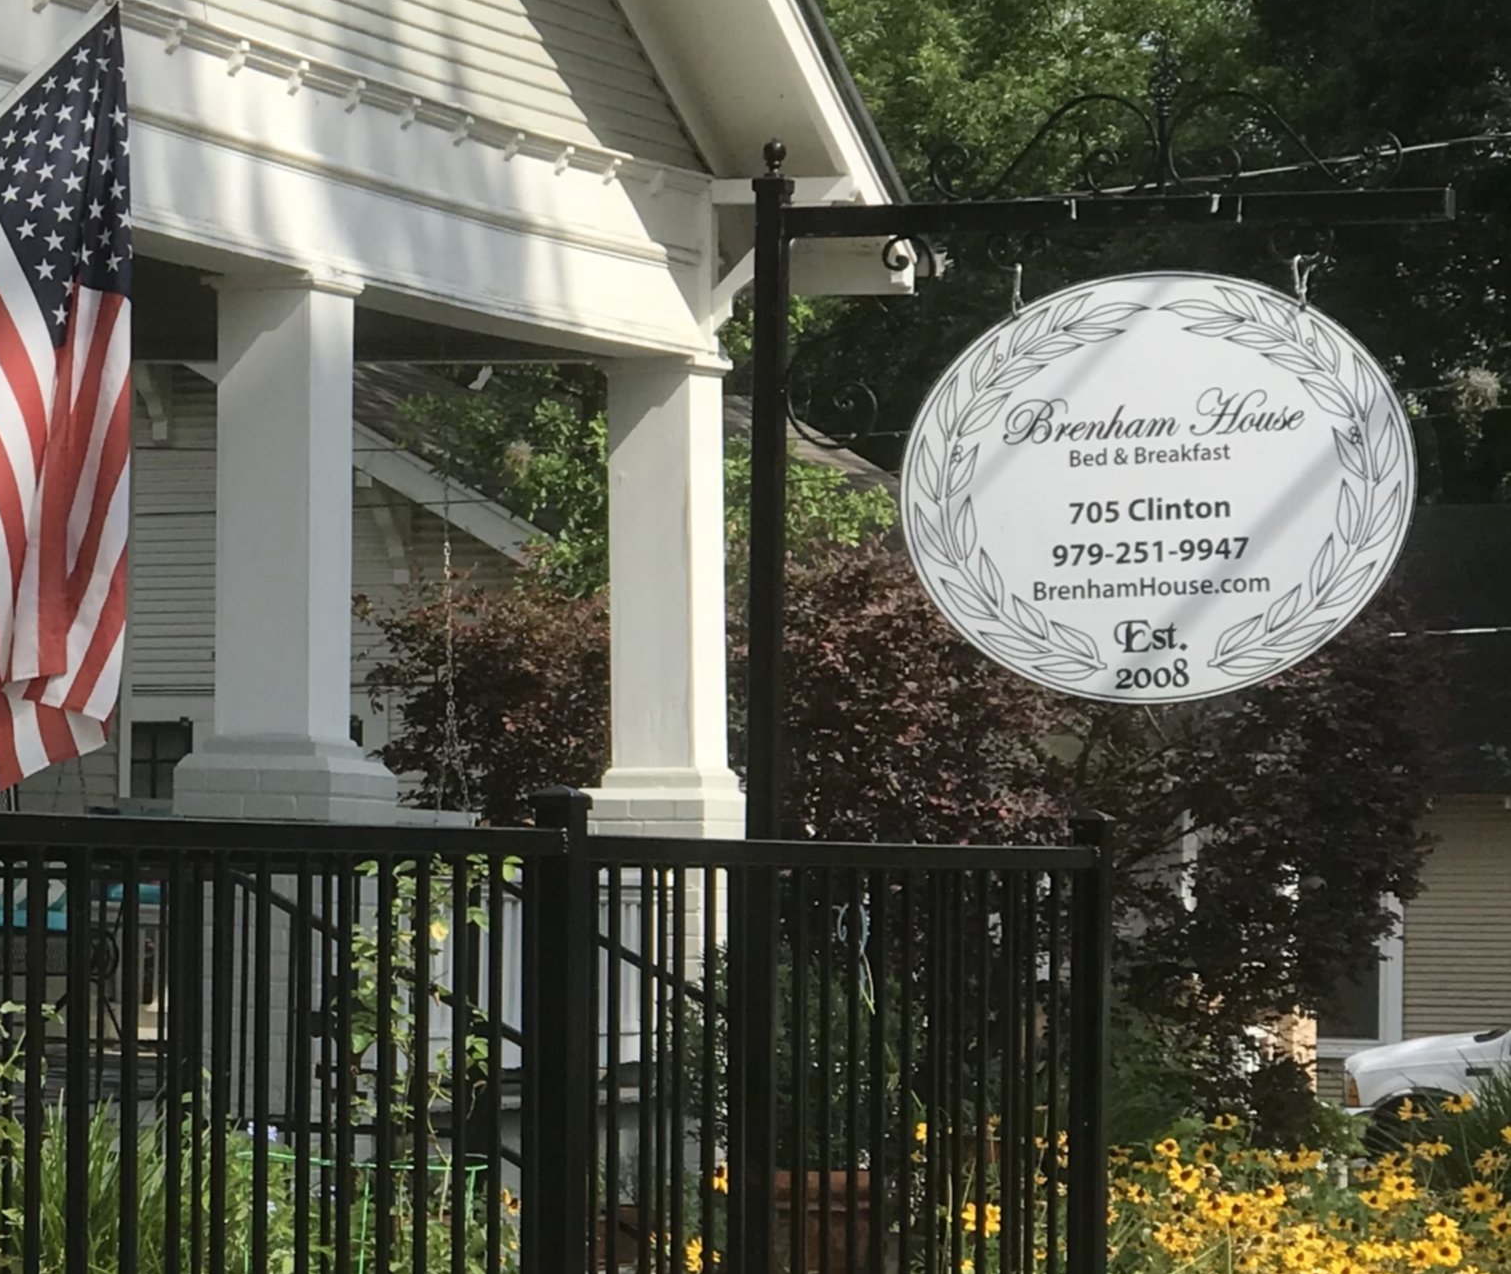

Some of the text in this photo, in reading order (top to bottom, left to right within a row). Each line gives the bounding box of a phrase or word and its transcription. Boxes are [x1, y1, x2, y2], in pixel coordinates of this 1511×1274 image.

[1002, 387, 1305, 445] Brenham House
[1069, 443, 1231, 468] Bed & Breakfast
[1069, 497, 1231, 524] 705 Clinton
[1052, 537, 1249, 566] 979-251-9947
[1033, 575, 1271, 602] BrenhamHouse.com
[1113, 619, 1189, 653] Est.
[1115, 658, 1190, 689] 2008
